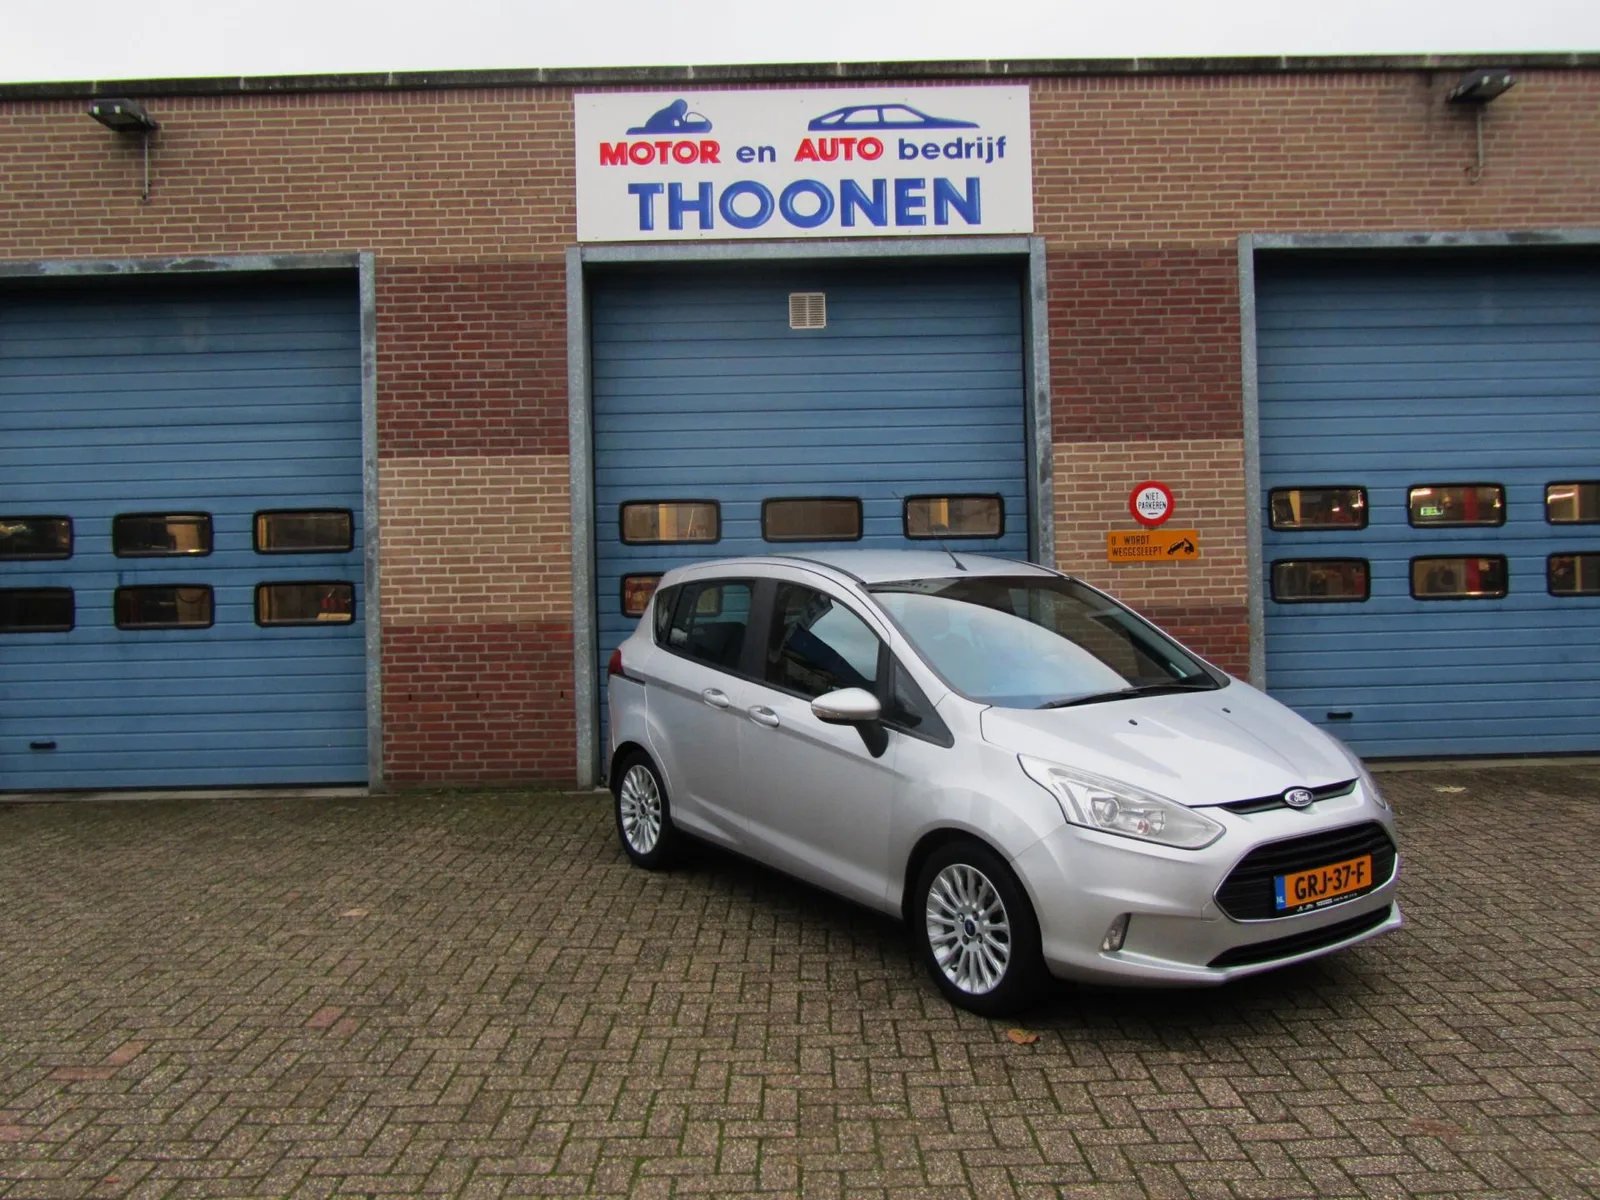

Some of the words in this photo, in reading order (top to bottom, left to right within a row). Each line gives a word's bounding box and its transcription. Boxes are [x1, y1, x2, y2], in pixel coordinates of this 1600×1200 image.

[600, 139, 721, 166] MOTOR
[735, 142, 776, 163] en
[794, 136, 884, 162] AUTO
[898, 135, 1007, 164] bedrijf
[627, 176, 982, 231] THOONEN
[1145, 492, 1160, 501] NIET
[1138, 501, 1167, 510] PARKEREN
[1124, 535, 1150, 545] WORDT
[1111, 546, 1163, 557] WEGGESLEEPT
[1294, 860, 1365, 901] GRJ-37-F
